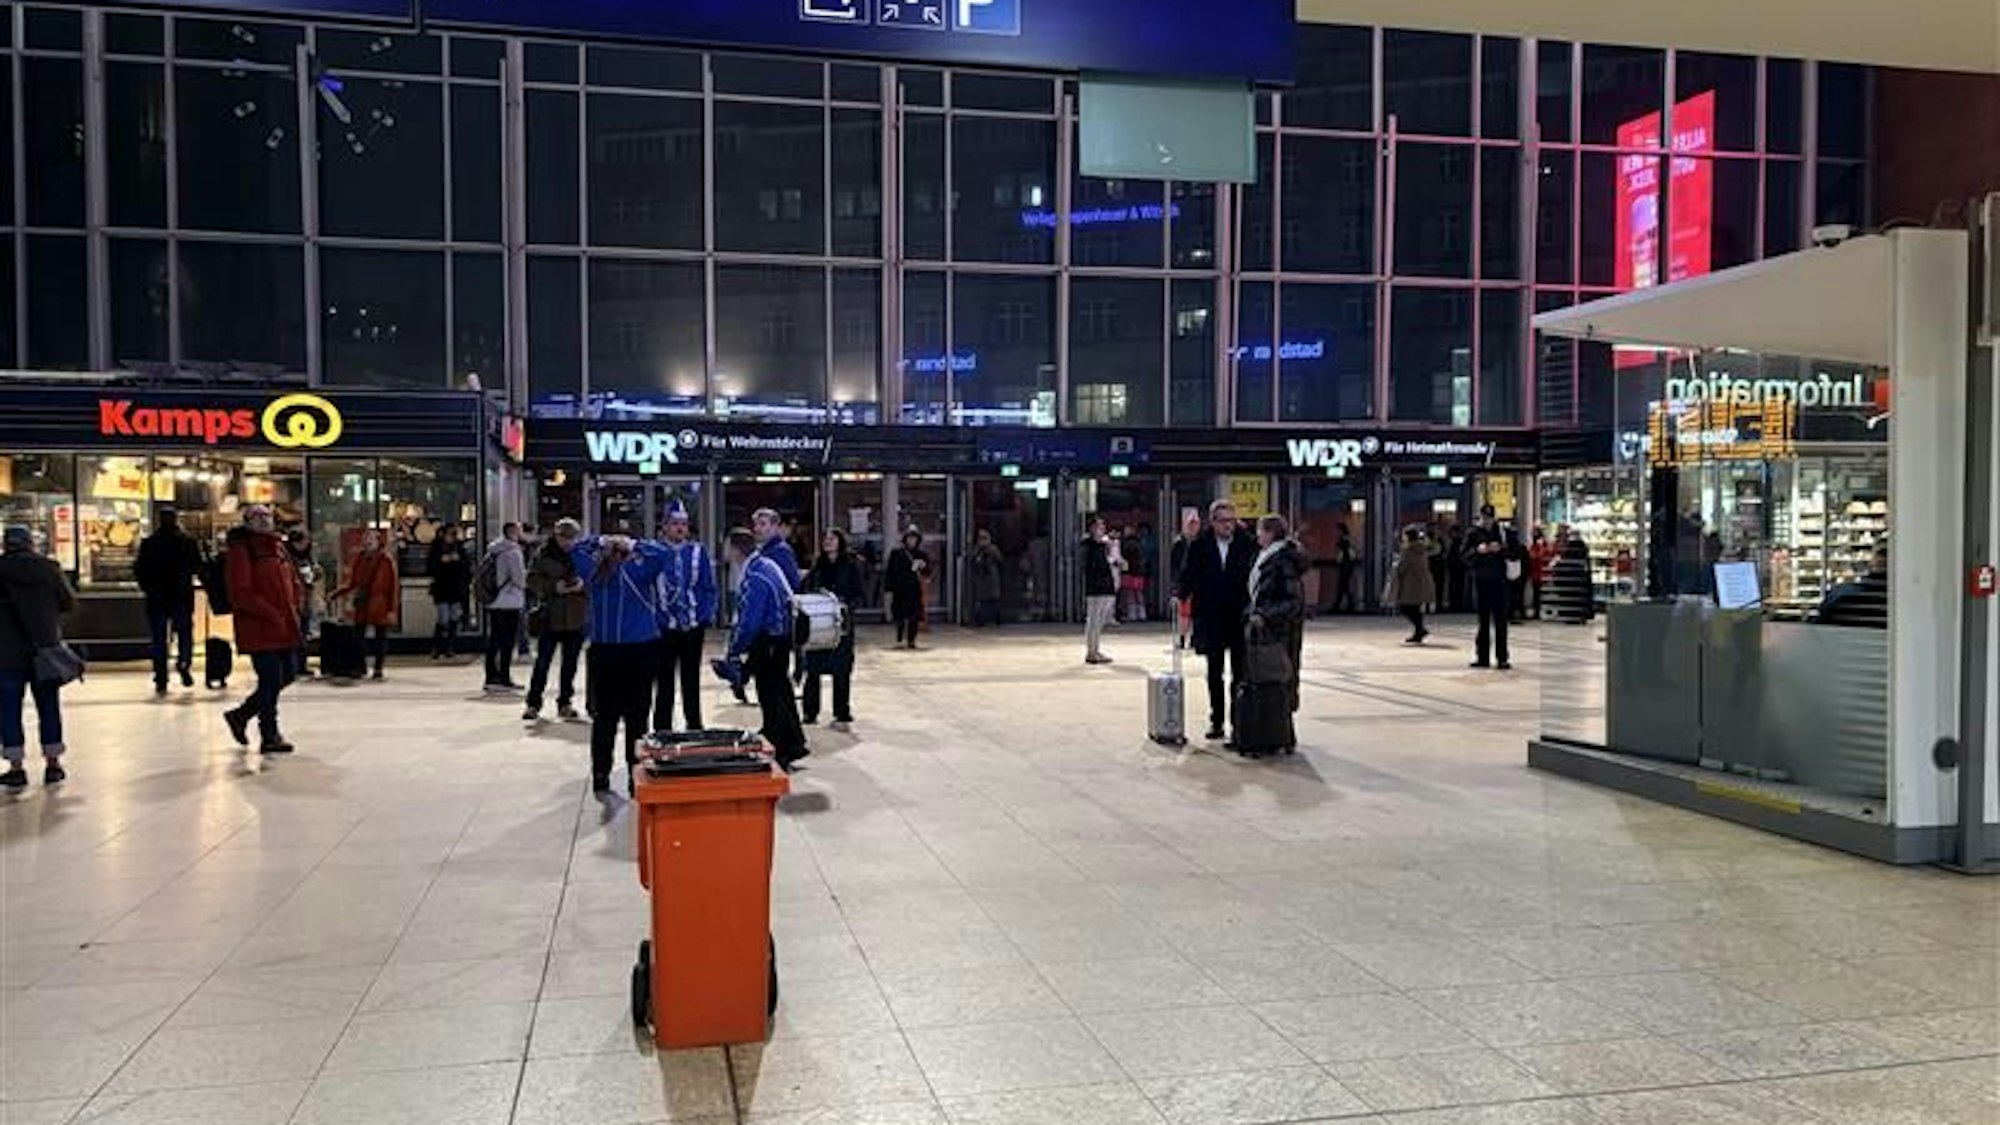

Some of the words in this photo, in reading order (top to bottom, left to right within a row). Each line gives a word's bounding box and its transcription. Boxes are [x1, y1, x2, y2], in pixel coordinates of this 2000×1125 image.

[99, 400, 256, 444] Kamps
[585, 432, 679, 463] WDR
[702, 435, 726, 448] Für
[1287, 438, 1363, 467] WDR
[1231, 481, 1262, 494] EXIT
